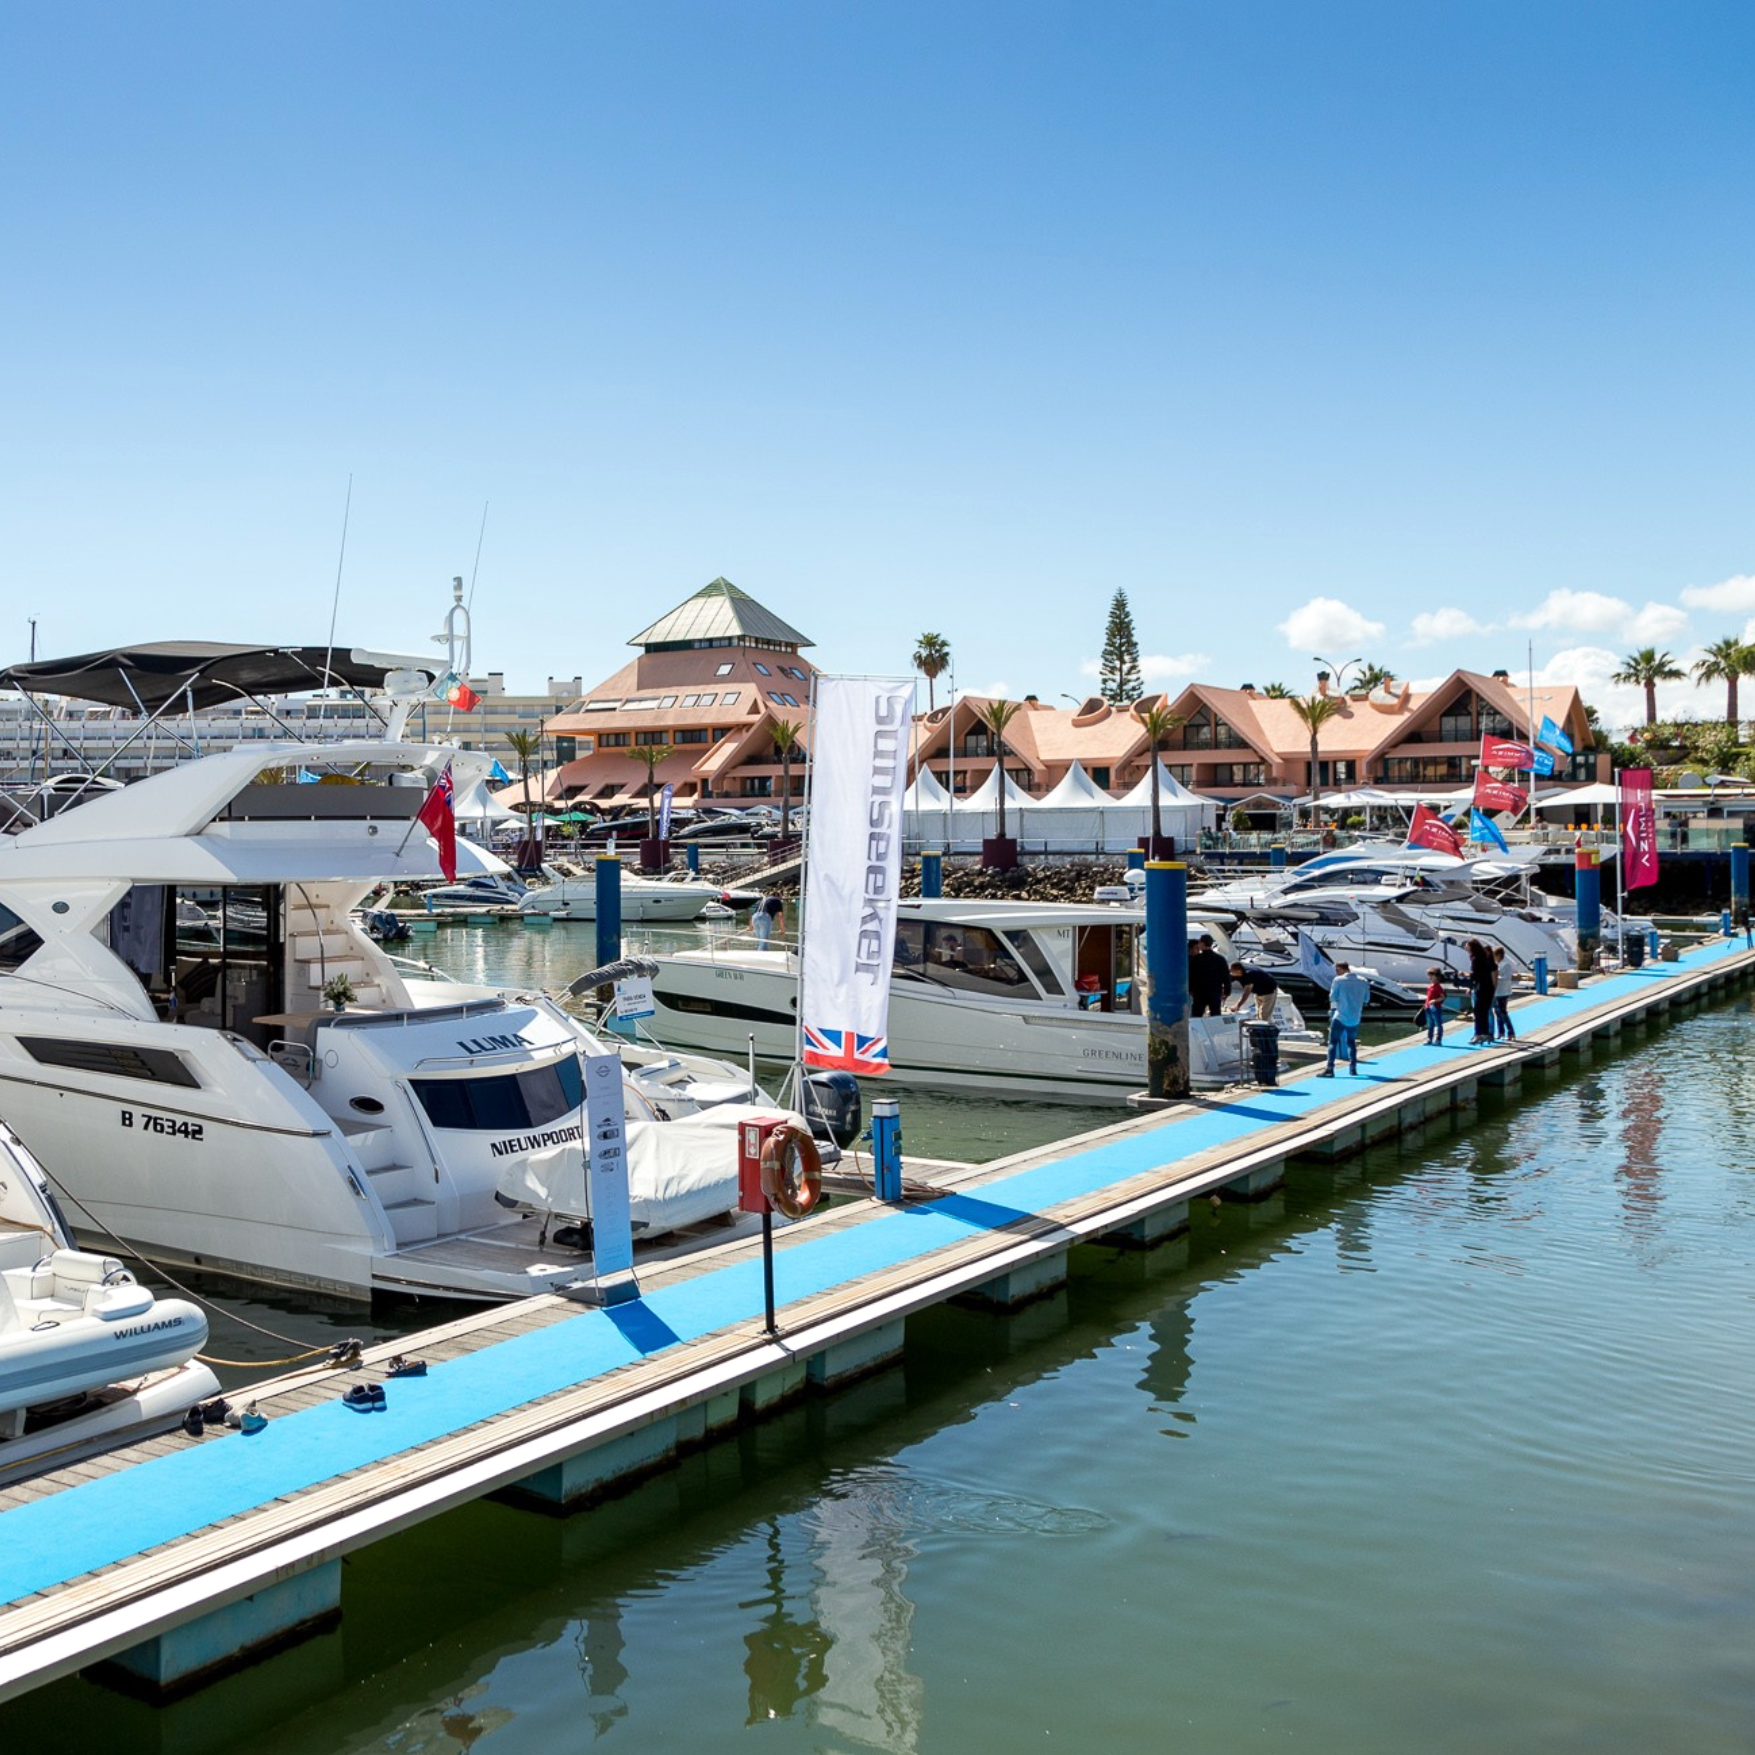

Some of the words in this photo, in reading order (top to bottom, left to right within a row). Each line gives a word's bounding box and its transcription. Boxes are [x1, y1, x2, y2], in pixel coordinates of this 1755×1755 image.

[854, 694, 906, 986] Sunseeker
[1637, 788, 1651, 867] AZIMUT
[456, 1033, 535, 1055] LUMA
[1083, 1048, 1145, 1062] GREENLINE
[121, 1110, 133, 1128] B
[141, 1113, 204, 1142] 76342
[490, 1125, 583, 1158] NIEUWPOORT
[113, 1316, 183, 1341] WILLIAMS
